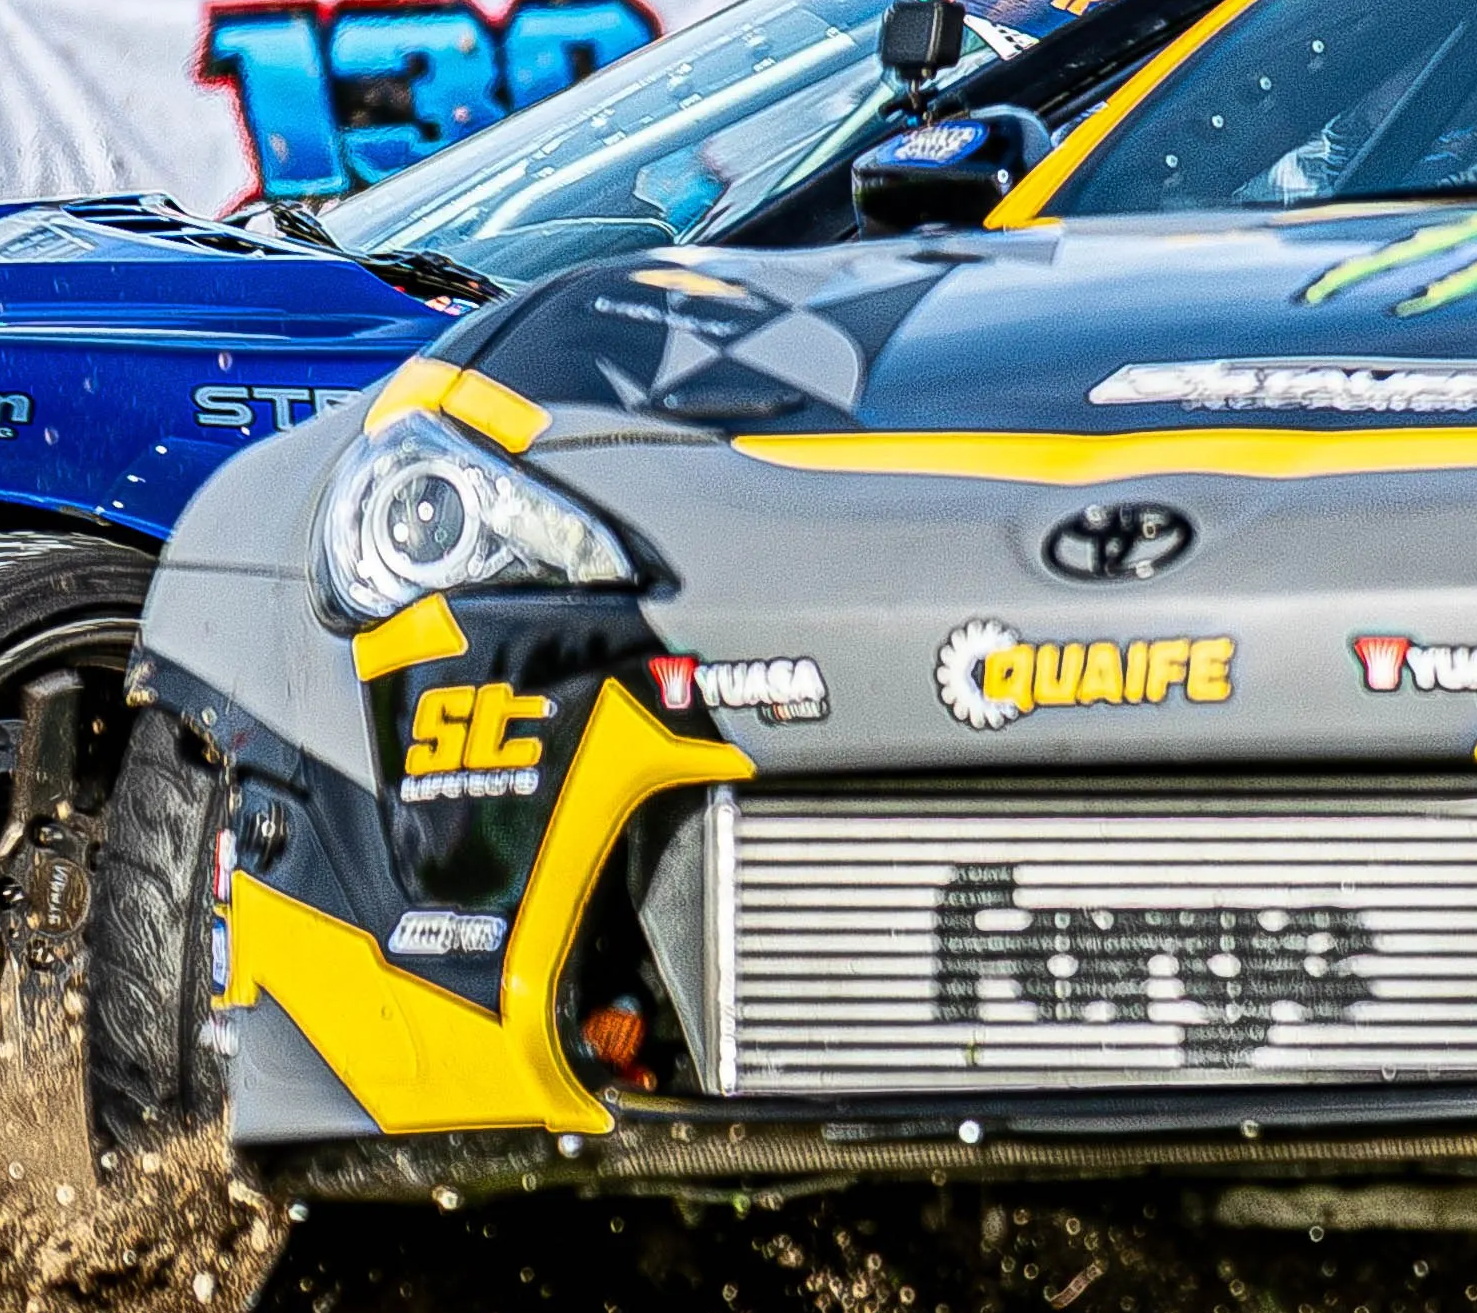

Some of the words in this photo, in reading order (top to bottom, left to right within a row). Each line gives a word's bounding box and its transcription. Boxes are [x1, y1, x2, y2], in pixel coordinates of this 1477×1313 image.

[693, 657, 826, 708] YUASA
[982, 635, 1236, 714] QUAIFE
[930, 860, 1381, 1071] Forge
